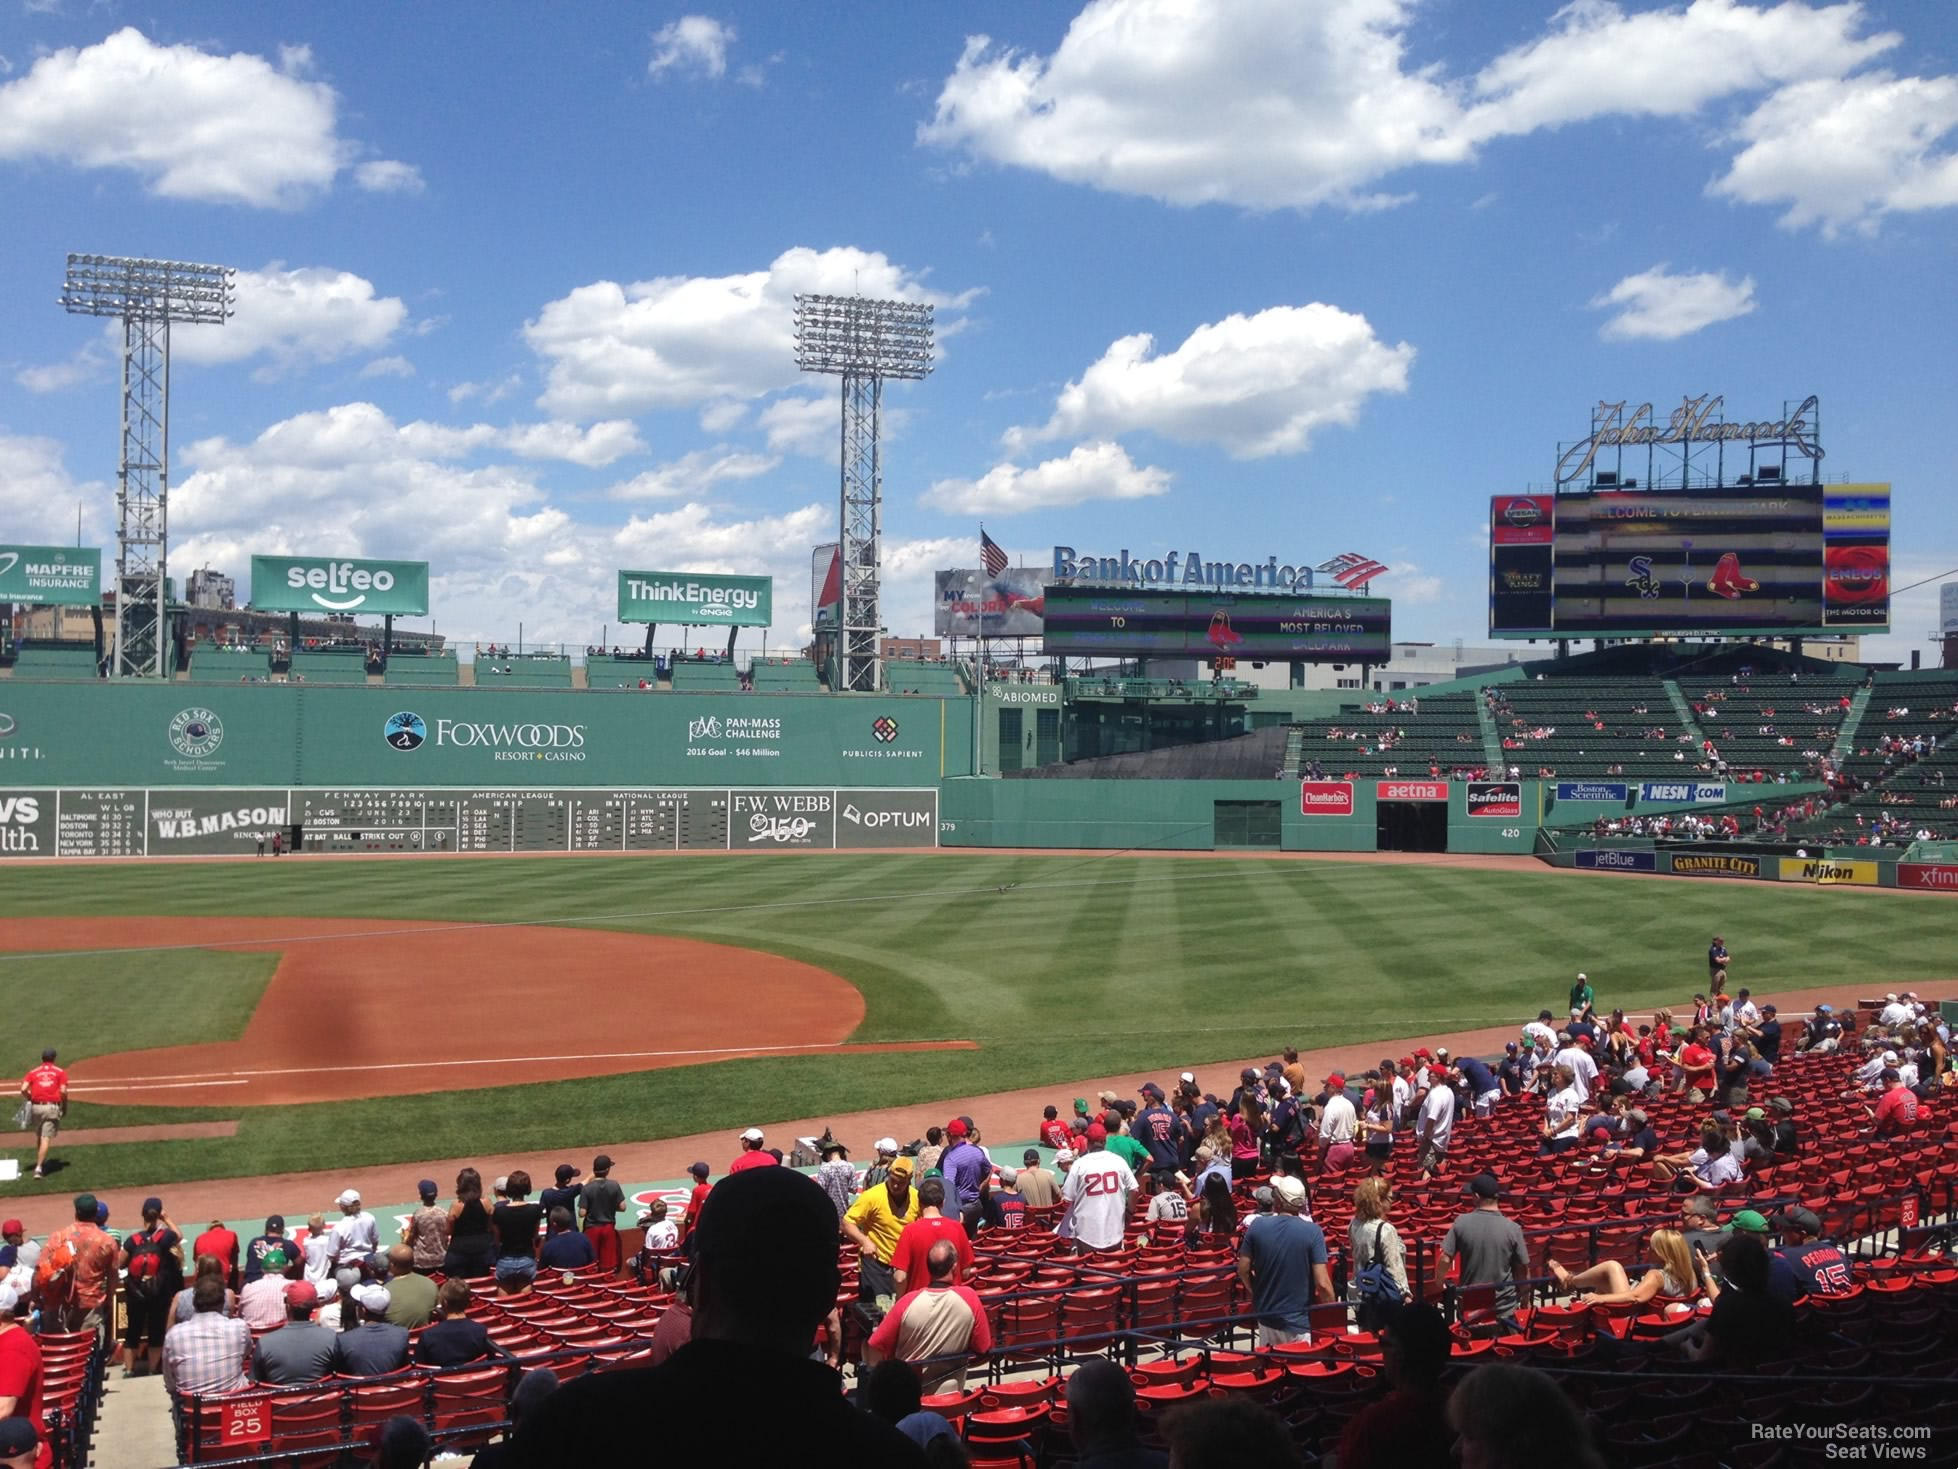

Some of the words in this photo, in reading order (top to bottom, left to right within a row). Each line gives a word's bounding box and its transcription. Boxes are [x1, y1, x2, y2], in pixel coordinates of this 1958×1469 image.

[1659, 393, 1825, 460] Hancock
[25, 563, 94, 577] MAPFRE
[1053, 545, 1139, 582] Bank
[1143, 551, 1178, 585] of
[1182, 551, 1314, 590] America
[29, 577, 89, 589] INSURANCE
[288, 562, 394, 594] selfeo
[627, 580, 758, 609] ThinkEnergy
[944, 590, 965, 601] MY
[1293, 608, 1352, 619] AMERICA'S
[1111, 617, 1125, 628] TO
[1280, 622, 1310, 633] MOST
[1314, 624, 1364, 635] BELOVED
[1002, 692, 1057, 703] ABIOMED
[172, 713, 189, 732] RED
[193, 710, 214, 723] SOX
[726, 718, 781, 728] PAN-MASS
[725, 729, 781, 739] CHALLENGE
[173, 727, 221, 755] SCHOLARS
[495, 752, 536, 761] RESORT
[545, 752, 585, 761] CASINO
[687, 748, 707, 756] 2016
[708, 748, 726, 756] Goal
[736, 748, 751, 757] $46
[752, 748, 780, 757] Million
[1388, 783, 1437, 797] aetna
[1577, 784, 1606, 792] Boston
[1468, 792, 1518, 803] Safelite
[1570, 790, 1617, 800] Scientific
[0, 797, 39, 823] VS
[123, 804, 135, 812] GB
[734, 796, 768, 812] F.W.
[773, 796, 831, 812] WEBB
[1482, 806, 1518, 814] AutoGlass
[61, 813, 98, 821] BALTIMORE
[151, 810, 174, 820] WHO
[175, 810, 193, 819] BUT
[864, 812, 930, 827] OPTUM
[60, 822, 88, 830] BOSTON
[100, 822, 110, 830] 39
[112, 822, 121, 830] 32
[158, 807, 287, 839] W.B.MASON
[940, 822, 956, 831] 379
[0, 826, 39, 851] lth
[1501, 828, 1520, 838] 420
[1594, 852, 1634, 867] jetBlue
[1674, 857, 1728, 871] GRANITE
[1729, 857, 1758, 875] CITY
[1802, 863, 1854, 880] Nikon
[1920, 867, 1958, 887] xfini
[1084, 1171, 1119, 1197] 20
[1171, 1202, 1186, 1219] 15
[1902, 1210, 1914, 1222] 20
[1004, 1213, 1025, 1229] 15
[234, 1408, 258, 1417] BOX
[230, 1418, 262, 1436] 25
